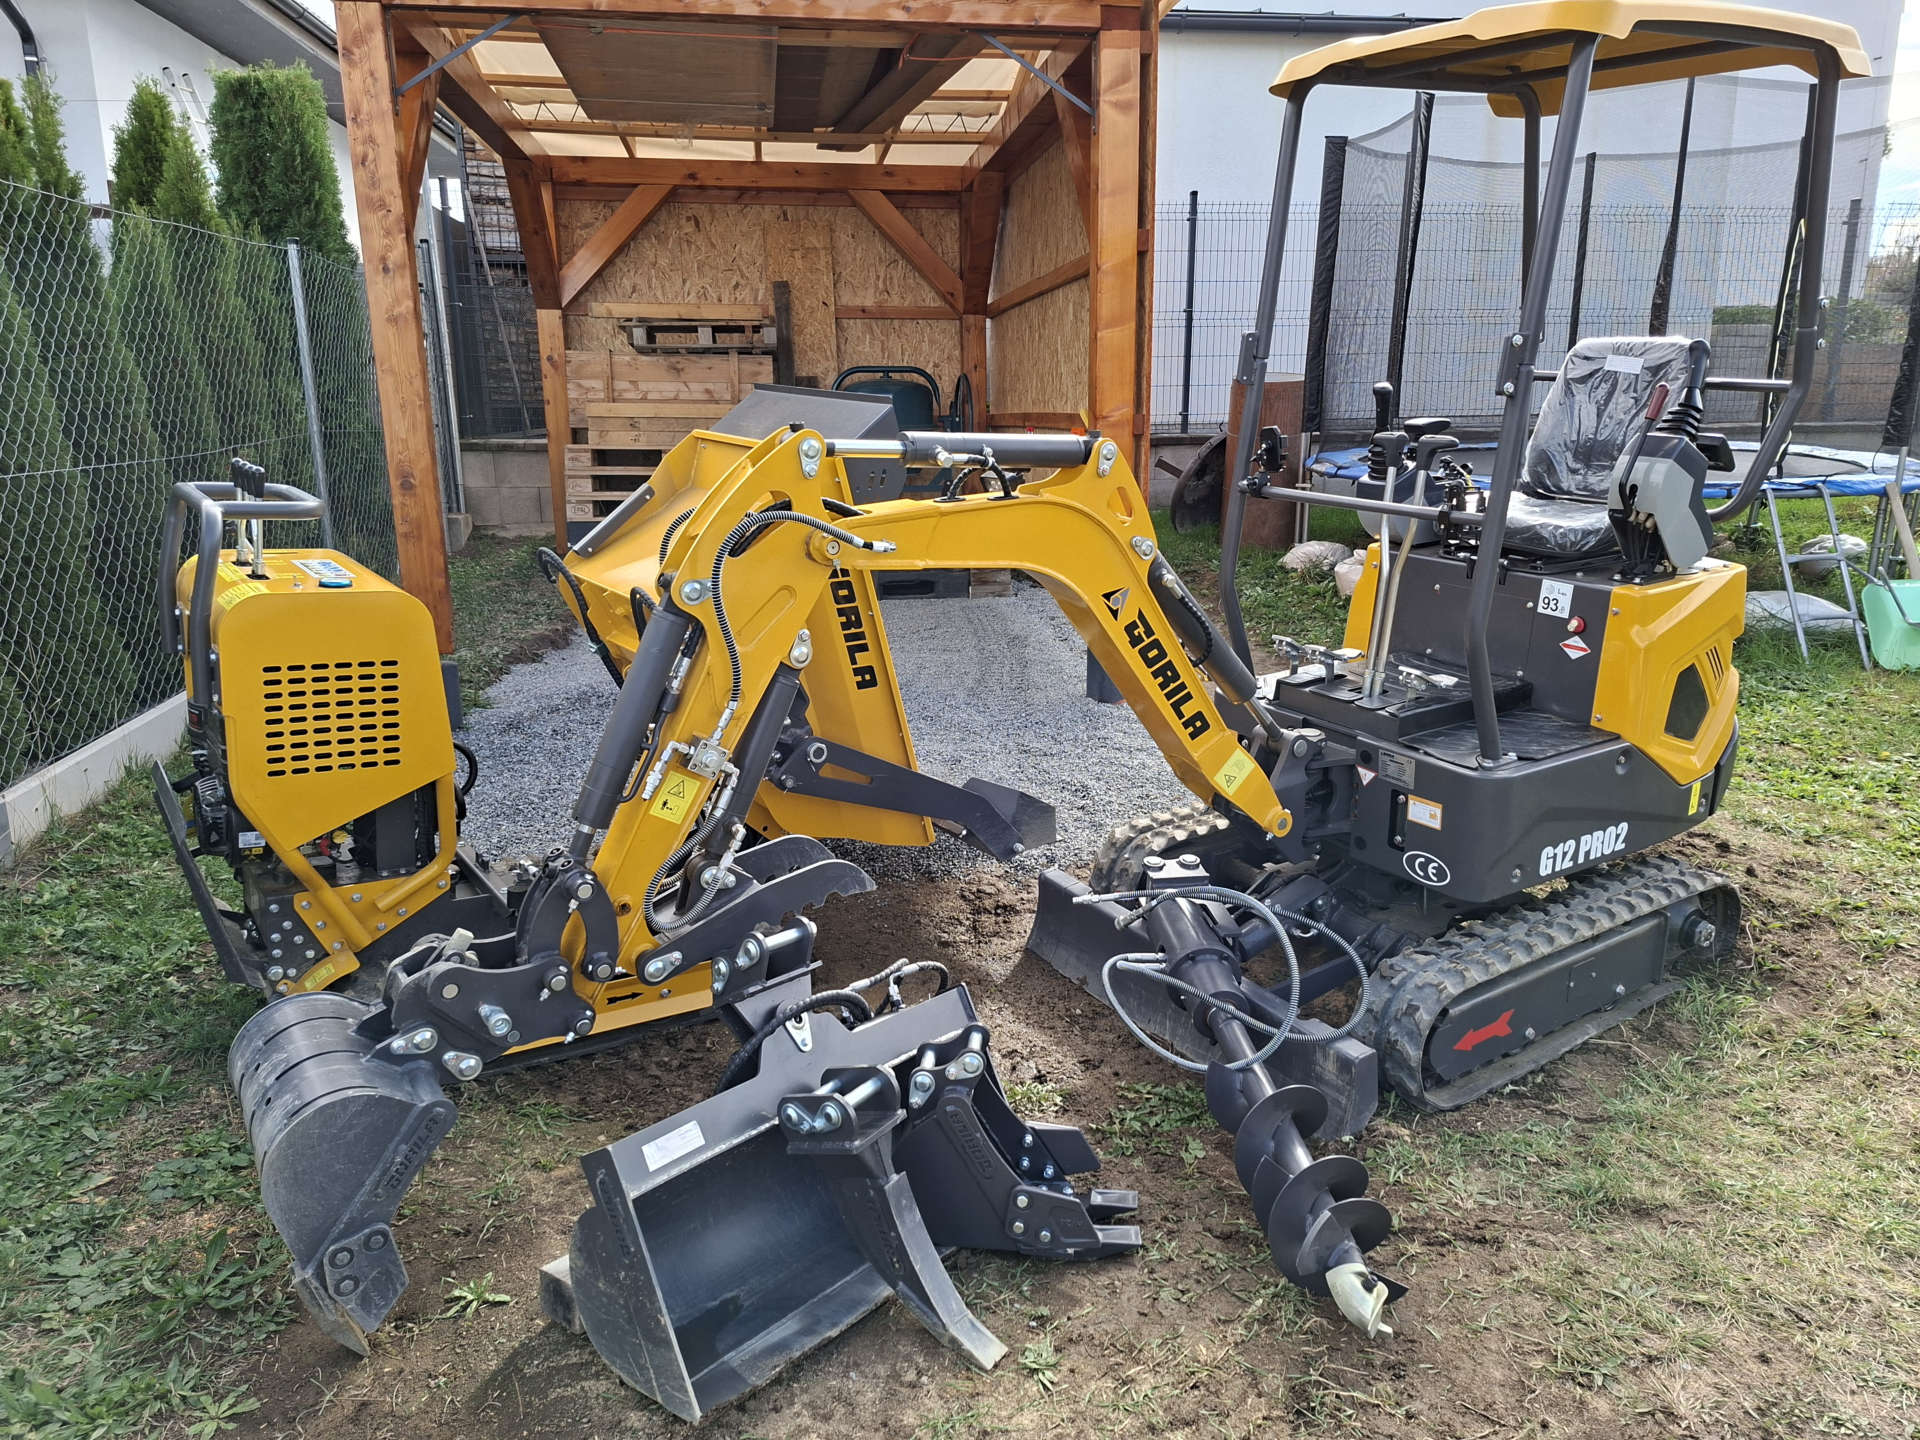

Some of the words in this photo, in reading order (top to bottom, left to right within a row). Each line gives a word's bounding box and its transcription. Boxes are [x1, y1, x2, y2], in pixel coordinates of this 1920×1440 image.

[1541, 596, 1559, 612] 93
[1124, 607, 1211, 741] GORILA
[1539, 839, 1576, 877] G12
[1577, 821, 1628, 864] PRO2
